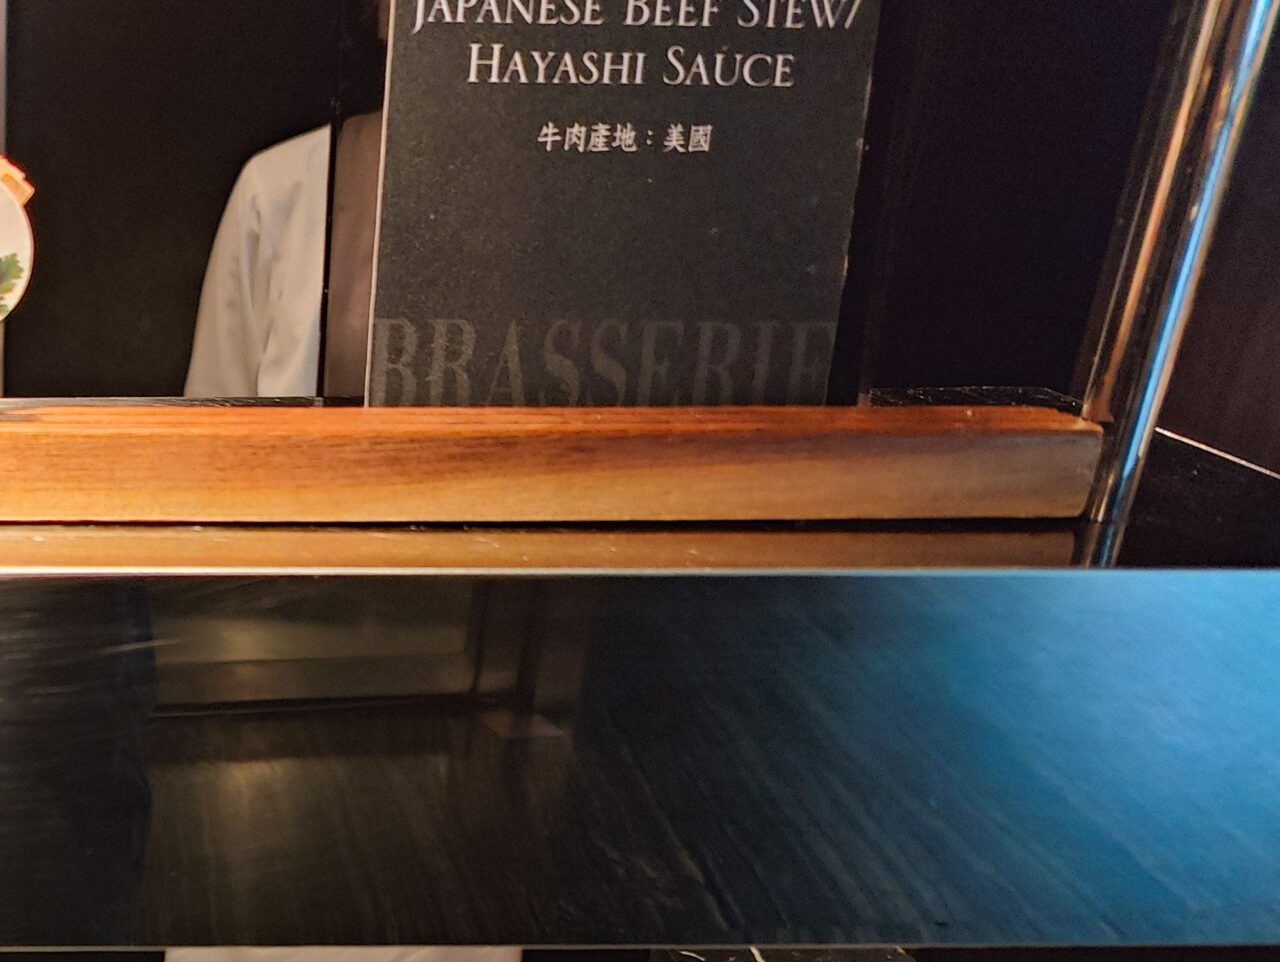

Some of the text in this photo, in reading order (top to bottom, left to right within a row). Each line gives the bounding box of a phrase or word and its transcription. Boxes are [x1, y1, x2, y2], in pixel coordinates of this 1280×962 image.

[411, 0, 604, 35] JAPANESE
[623, 0, 719, 27] BEEF
[467, 43, 796, 87] HAYASHI SAUCE
